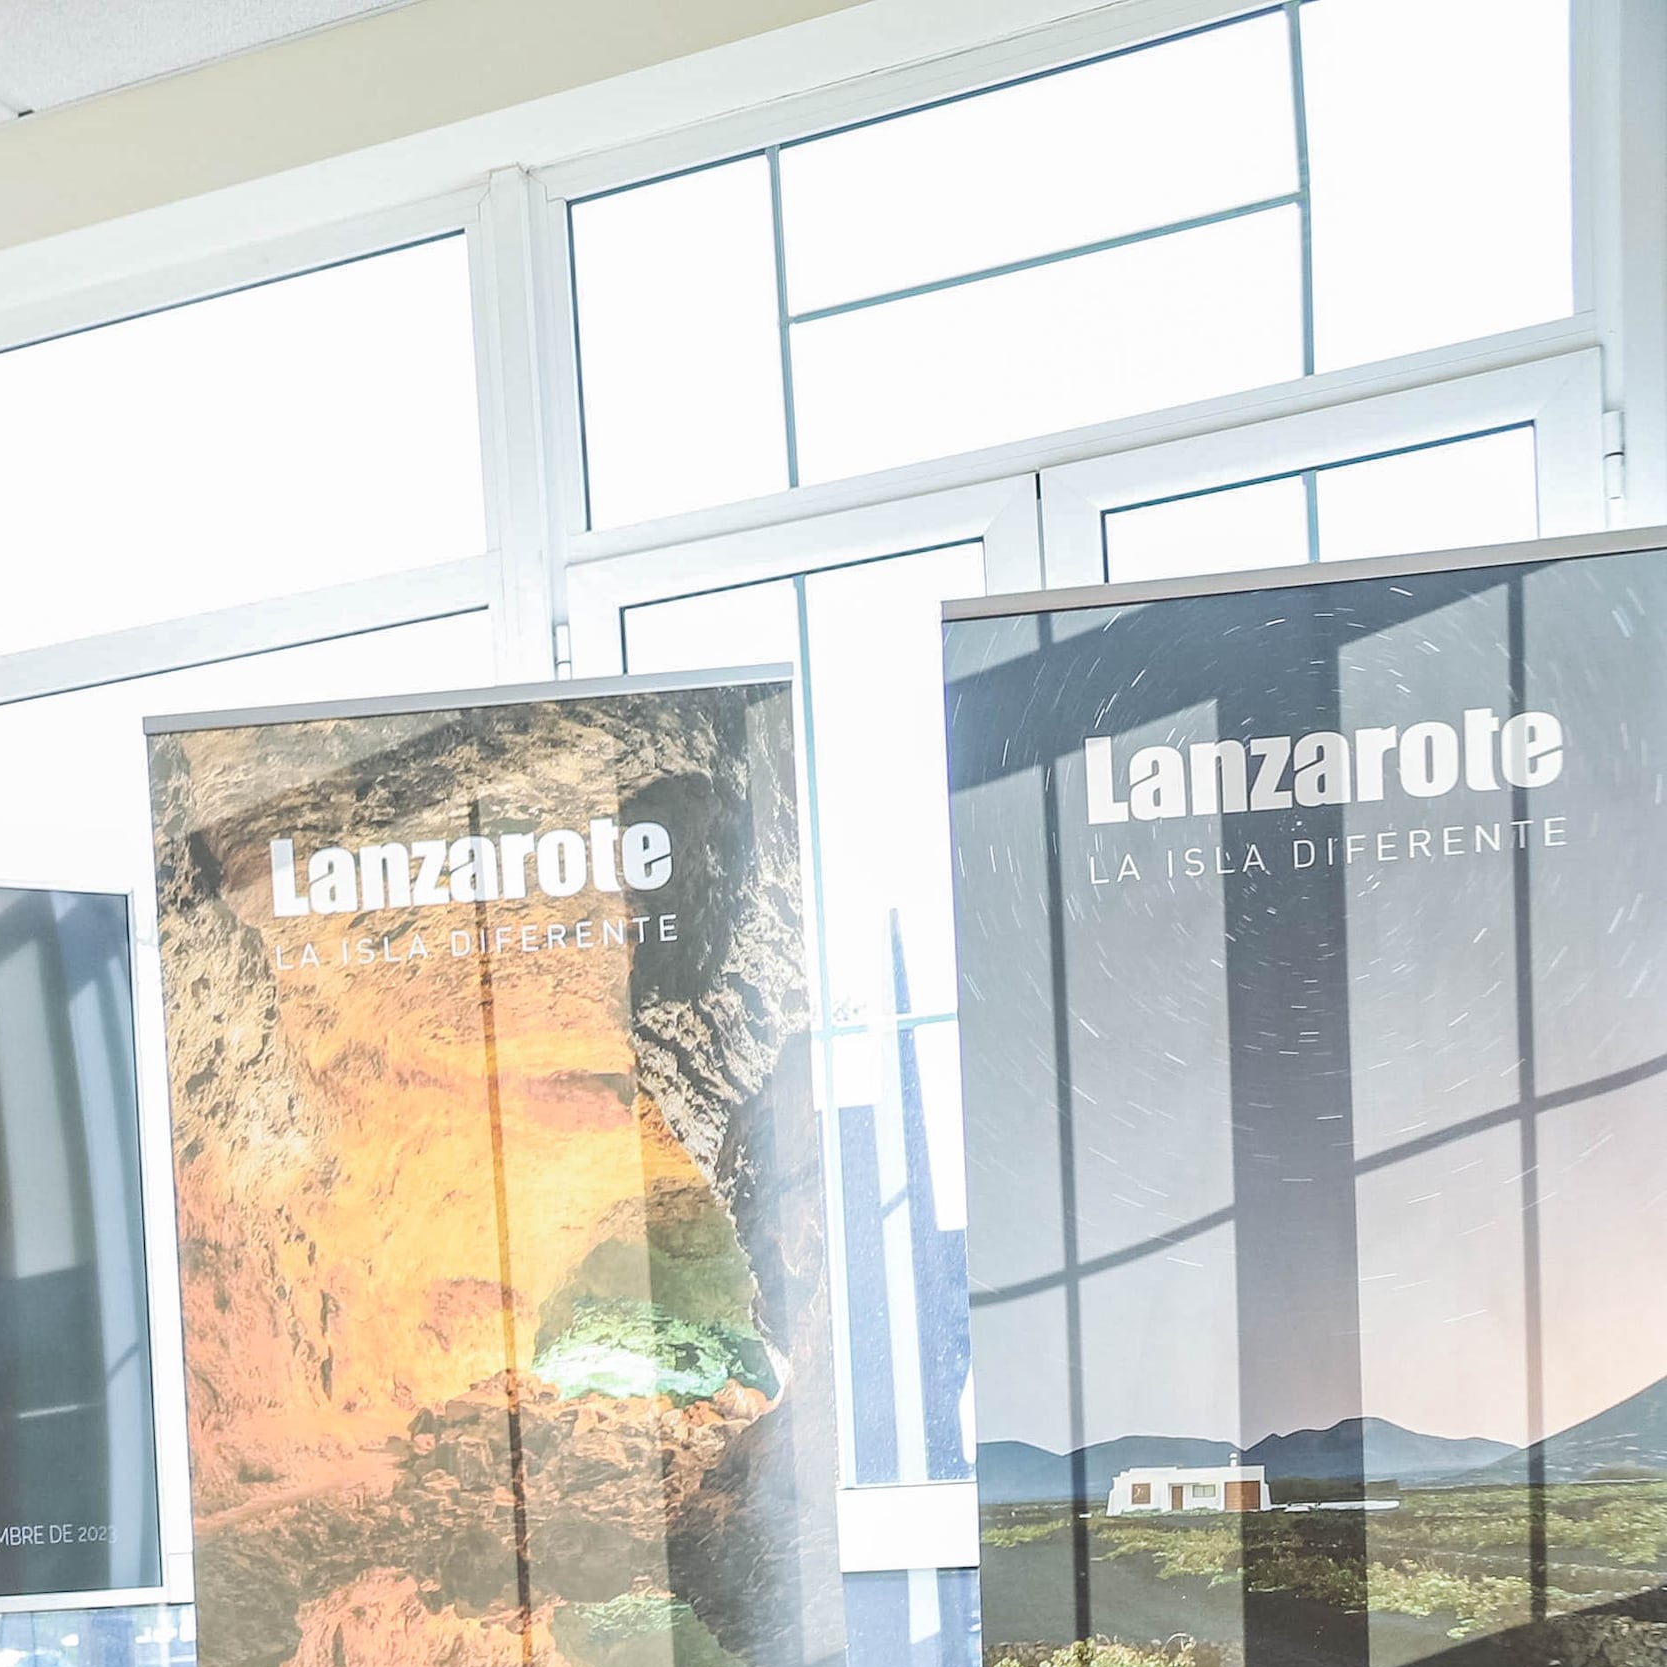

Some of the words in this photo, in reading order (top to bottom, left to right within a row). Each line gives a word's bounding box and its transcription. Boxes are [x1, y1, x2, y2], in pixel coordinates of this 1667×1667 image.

[1085, 707, 1564, 825] Lanzarote
[270, 817, 672, 918] Lanzarote
[1090, 853, 1141, 885] LA
[1167, 844, 1267, 877] ISLA
[1292, 816, 1567, 869] DIFERENTE
[274, 942, 321, 971] LA
[342, 934, 428, 965] ISLA
[450, 913, 679, 957] DIFERENTE
[49, 1524, 73, 1544] DE
[77, 1525, 119, 1544] 2023
